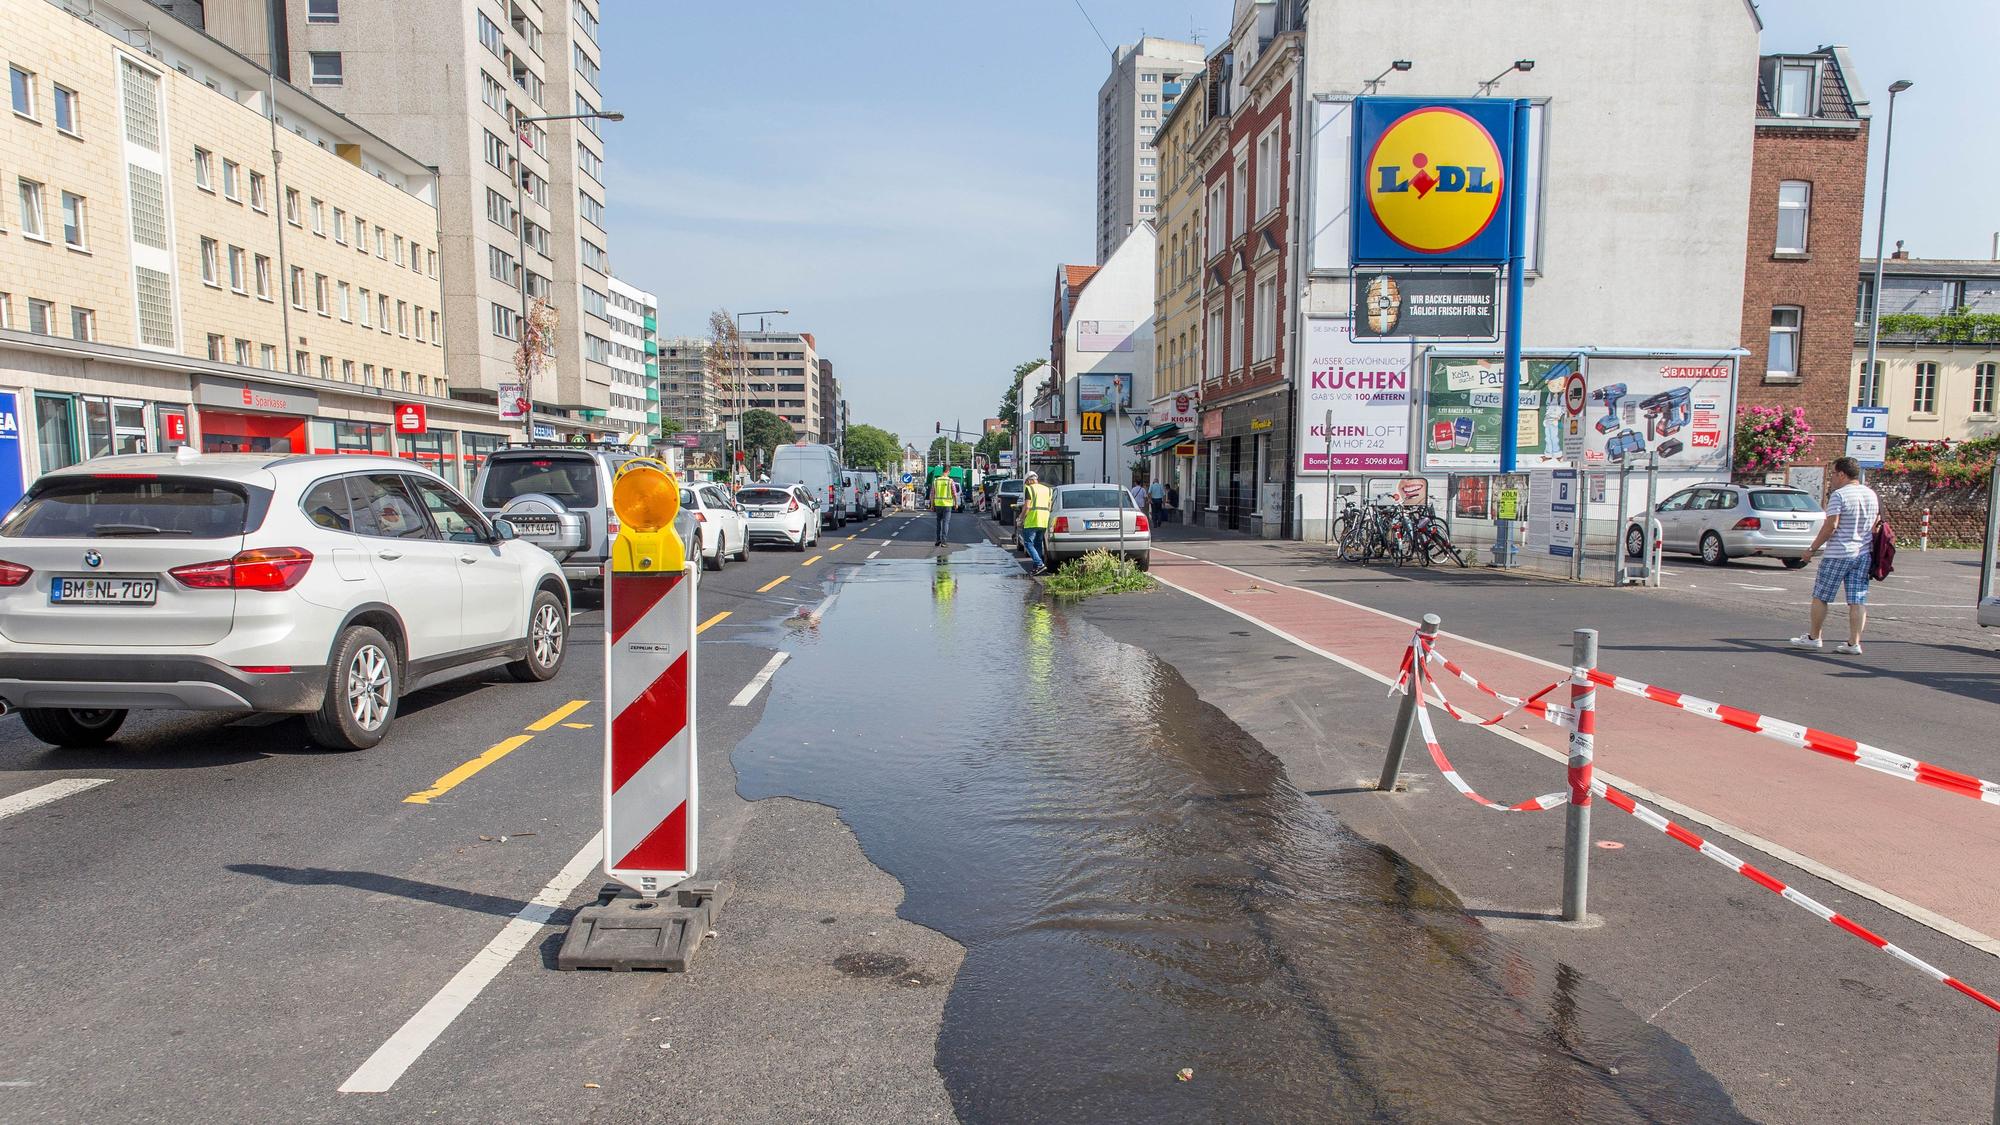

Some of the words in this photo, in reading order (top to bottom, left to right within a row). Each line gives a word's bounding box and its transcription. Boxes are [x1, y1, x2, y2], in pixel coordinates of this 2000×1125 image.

[1410, 295, 1424, 304] WIR
[1425, 295, 1451, 304] BACKEN
[1452, 295, 1490, 304] MEHRMALS
[1410, 304, 1437, 316] TÄGLICH
[1438, 306, 1462, 316] FRISCH
[1463, 304, 1477, 316] FÜR
[1478, 306, 1490, 316] SIE.
[1312, 357, 1343, 366] AUSSER
[1344, 355, 1407, 366] GEWÖHNLICHE
[1311, 366, 1406, 390] KÜCHEN
[1671, 367, 1728, 378] BAUHAUS
[254, 395, 287, 409] Sparkasse
[1312, 393, 1335, 401] GAB'S
[1336, 393, 1353, 401] VOR
[1355, 393, 1371, 401] 100
[1372, 393, 1406, 401] METERN
[1473, 392, 1500, 406] gute
[1343, 440, 1364, 449] HOF
[1367, 440, 1385, 449] 242
[1308, 457, 1330, 466] Bonne
[1333, 457, 1344, 466] Str.
[1345, 457, 1359, 466] 242
[1365, 457, 1388, 466] 50968
[1388, 457, 1404, 466] Köln
[536, 522, 554, 532] 4444
[62, 581, 85, 598] BM
[95, 581, 118, 599] NL
[121, 582, 153, 599] 709
